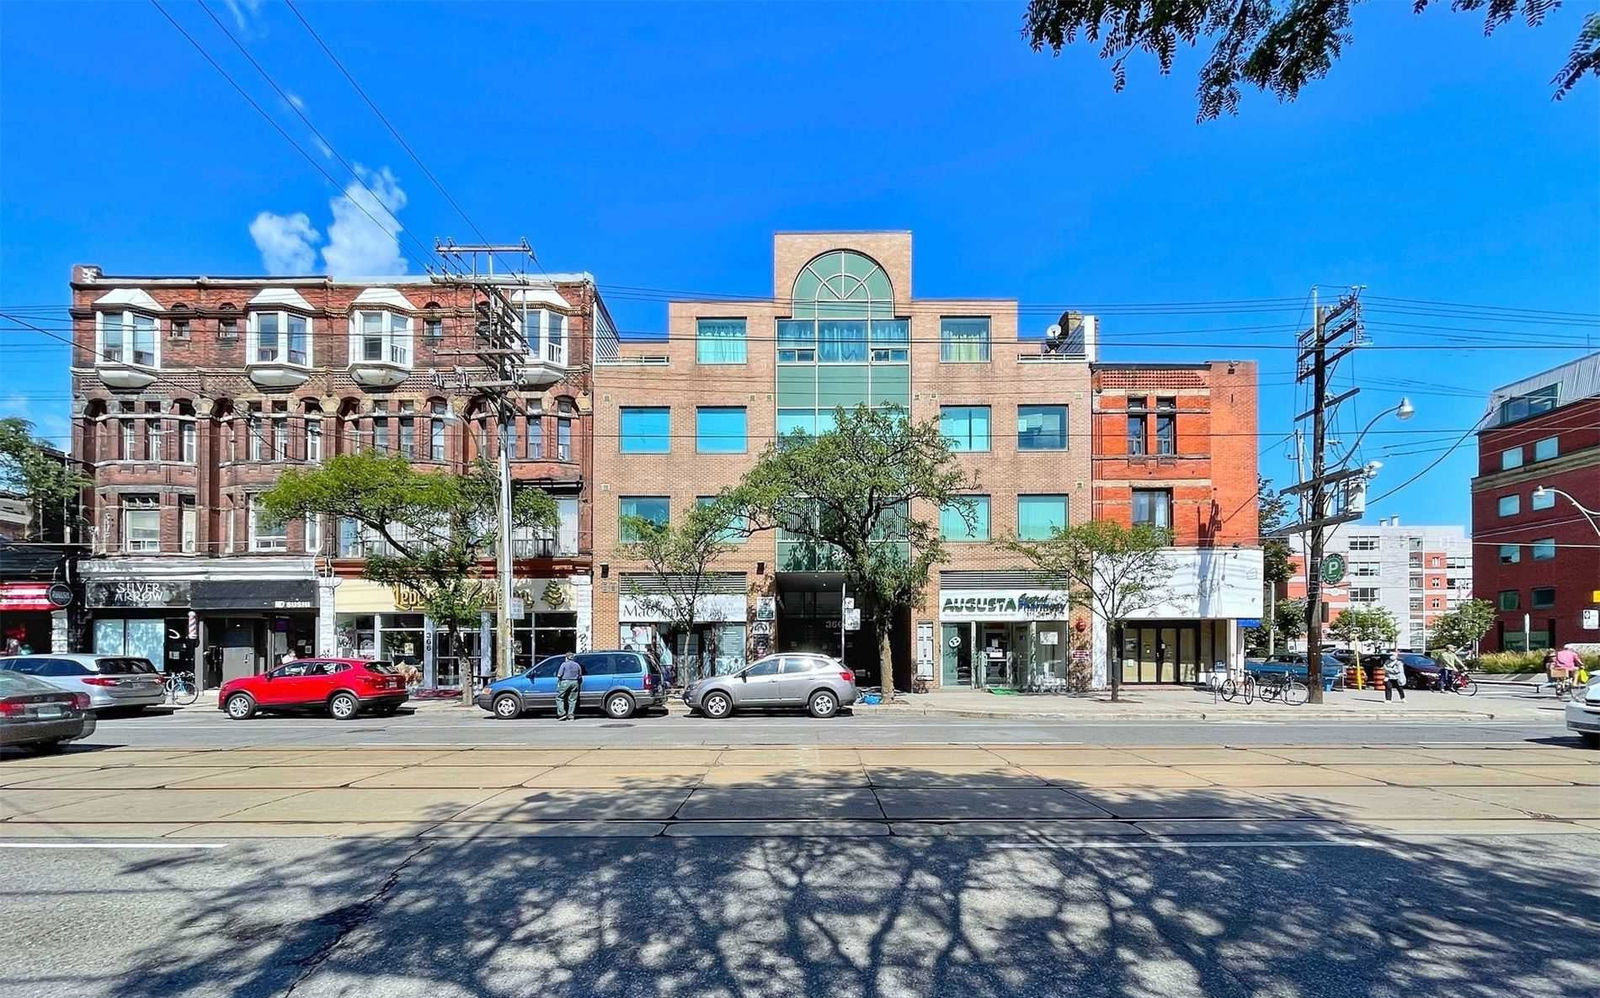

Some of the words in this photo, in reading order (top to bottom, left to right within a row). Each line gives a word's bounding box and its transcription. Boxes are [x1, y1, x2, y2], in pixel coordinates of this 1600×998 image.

[115, 582, 160, 593] SILVER
[114, 592, 163, 602] ARROW
[942, 597, 1017, 613] AUGUSTA
